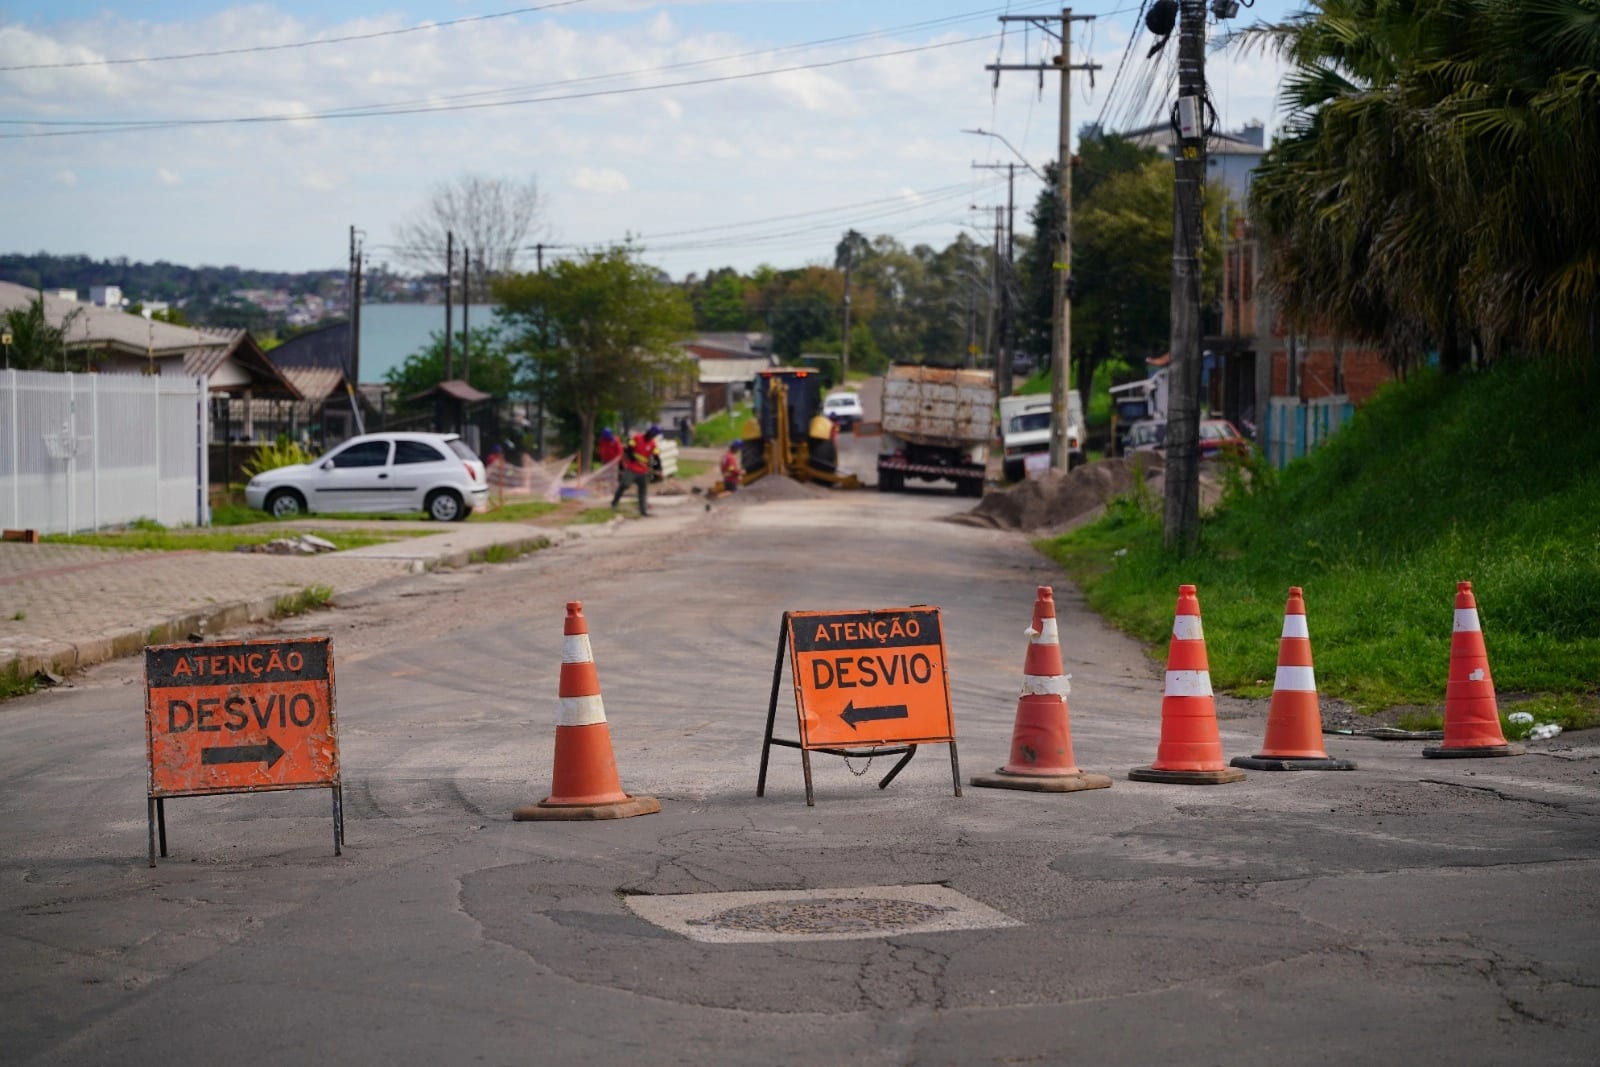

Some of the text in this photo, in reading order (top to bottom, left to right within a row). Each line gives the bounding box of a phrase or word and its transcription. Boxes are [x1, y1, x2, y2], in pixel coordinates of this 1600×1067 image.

[815, 617, 920, 643] ATENÇÃO
[173, 649, 304, 678] ATENÇÃO
[812, 653, 931, 690] DESVIO
[168, 693, 315, 733] DESVIO
